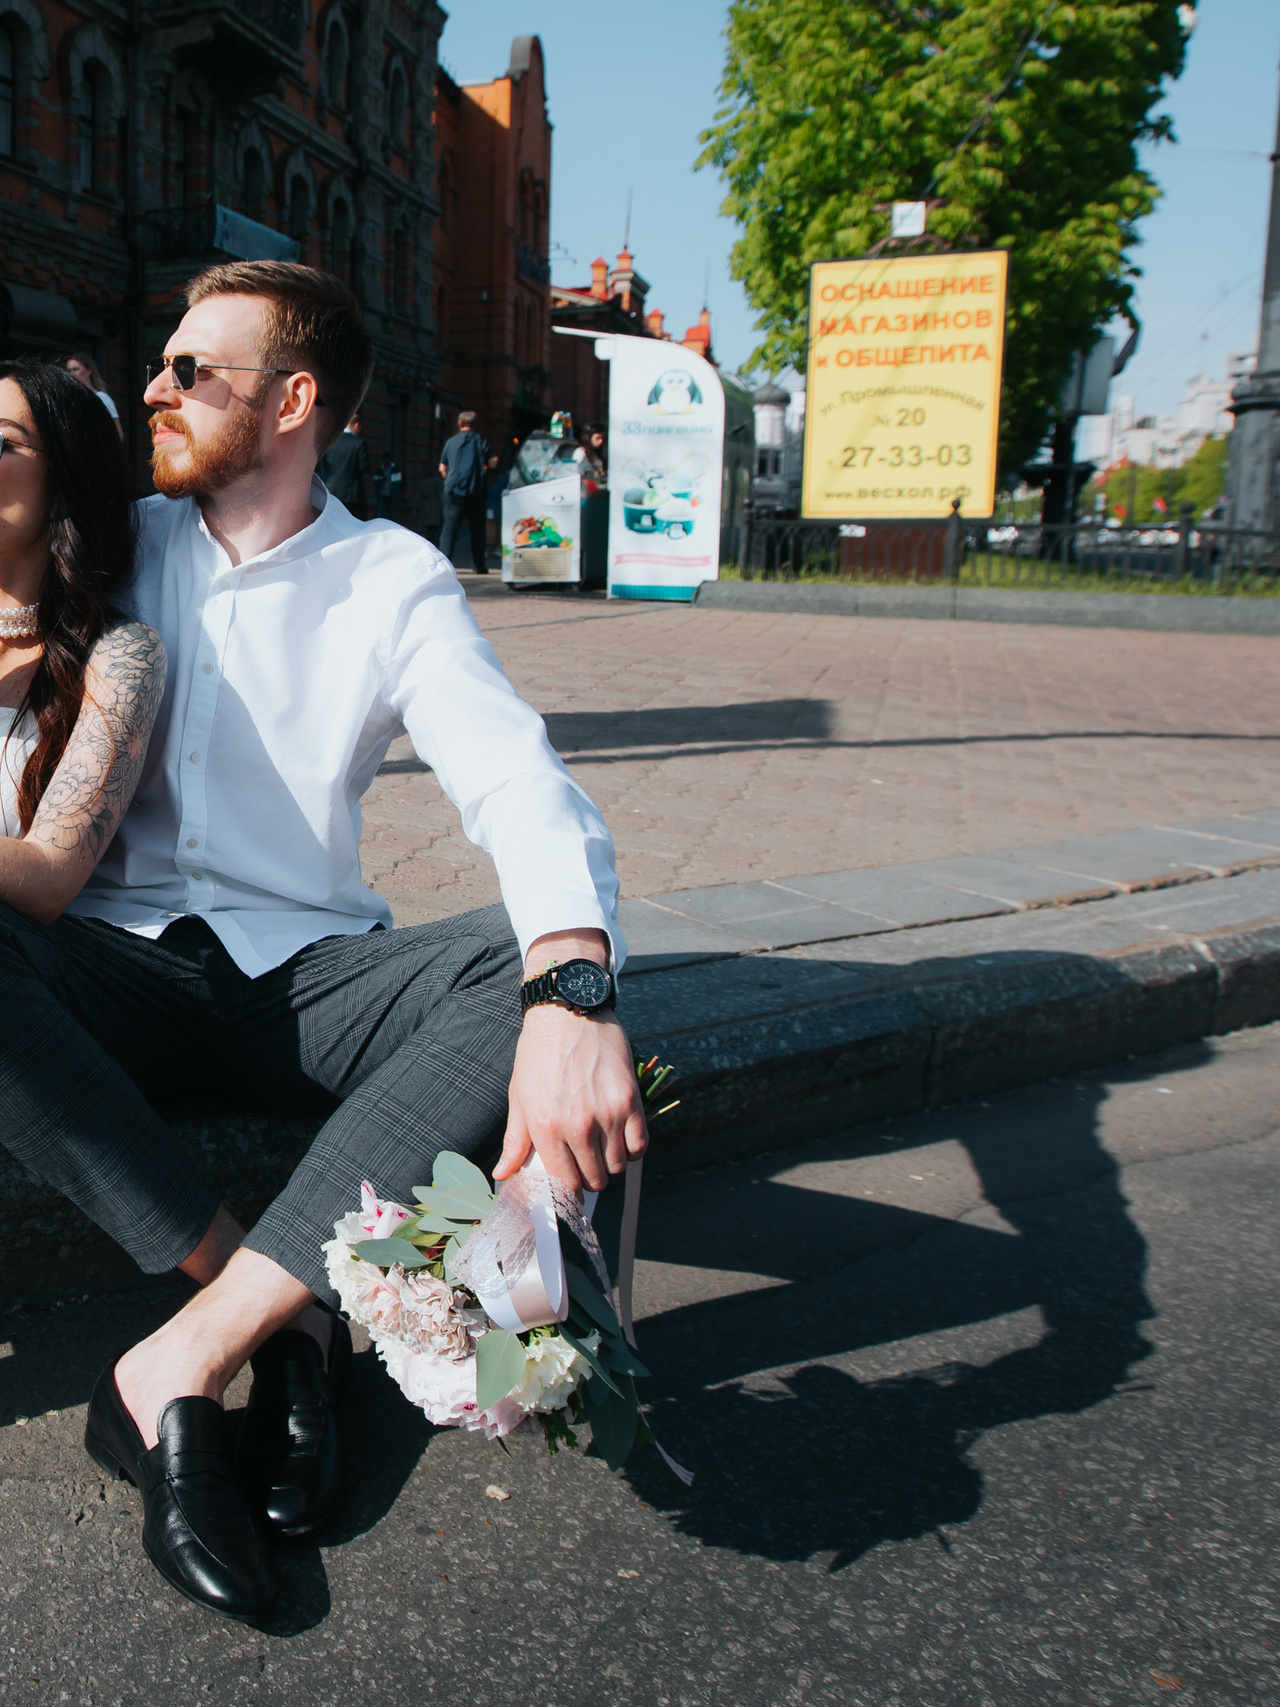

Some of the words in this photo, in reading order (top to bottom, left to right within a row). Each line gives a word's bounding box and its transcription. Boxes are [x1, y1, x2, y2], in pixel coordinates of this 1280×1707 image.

[821, 275, 995, 302] ОСНАЩЕНИЕ
[820, 310, 992, 335] МАГАЗИНОВ
[835, 343, 990, 369] ОБЩЕПИТА
[896, 408, 926, 426] 20
[842, 444, 972, 468] 27-33-03
